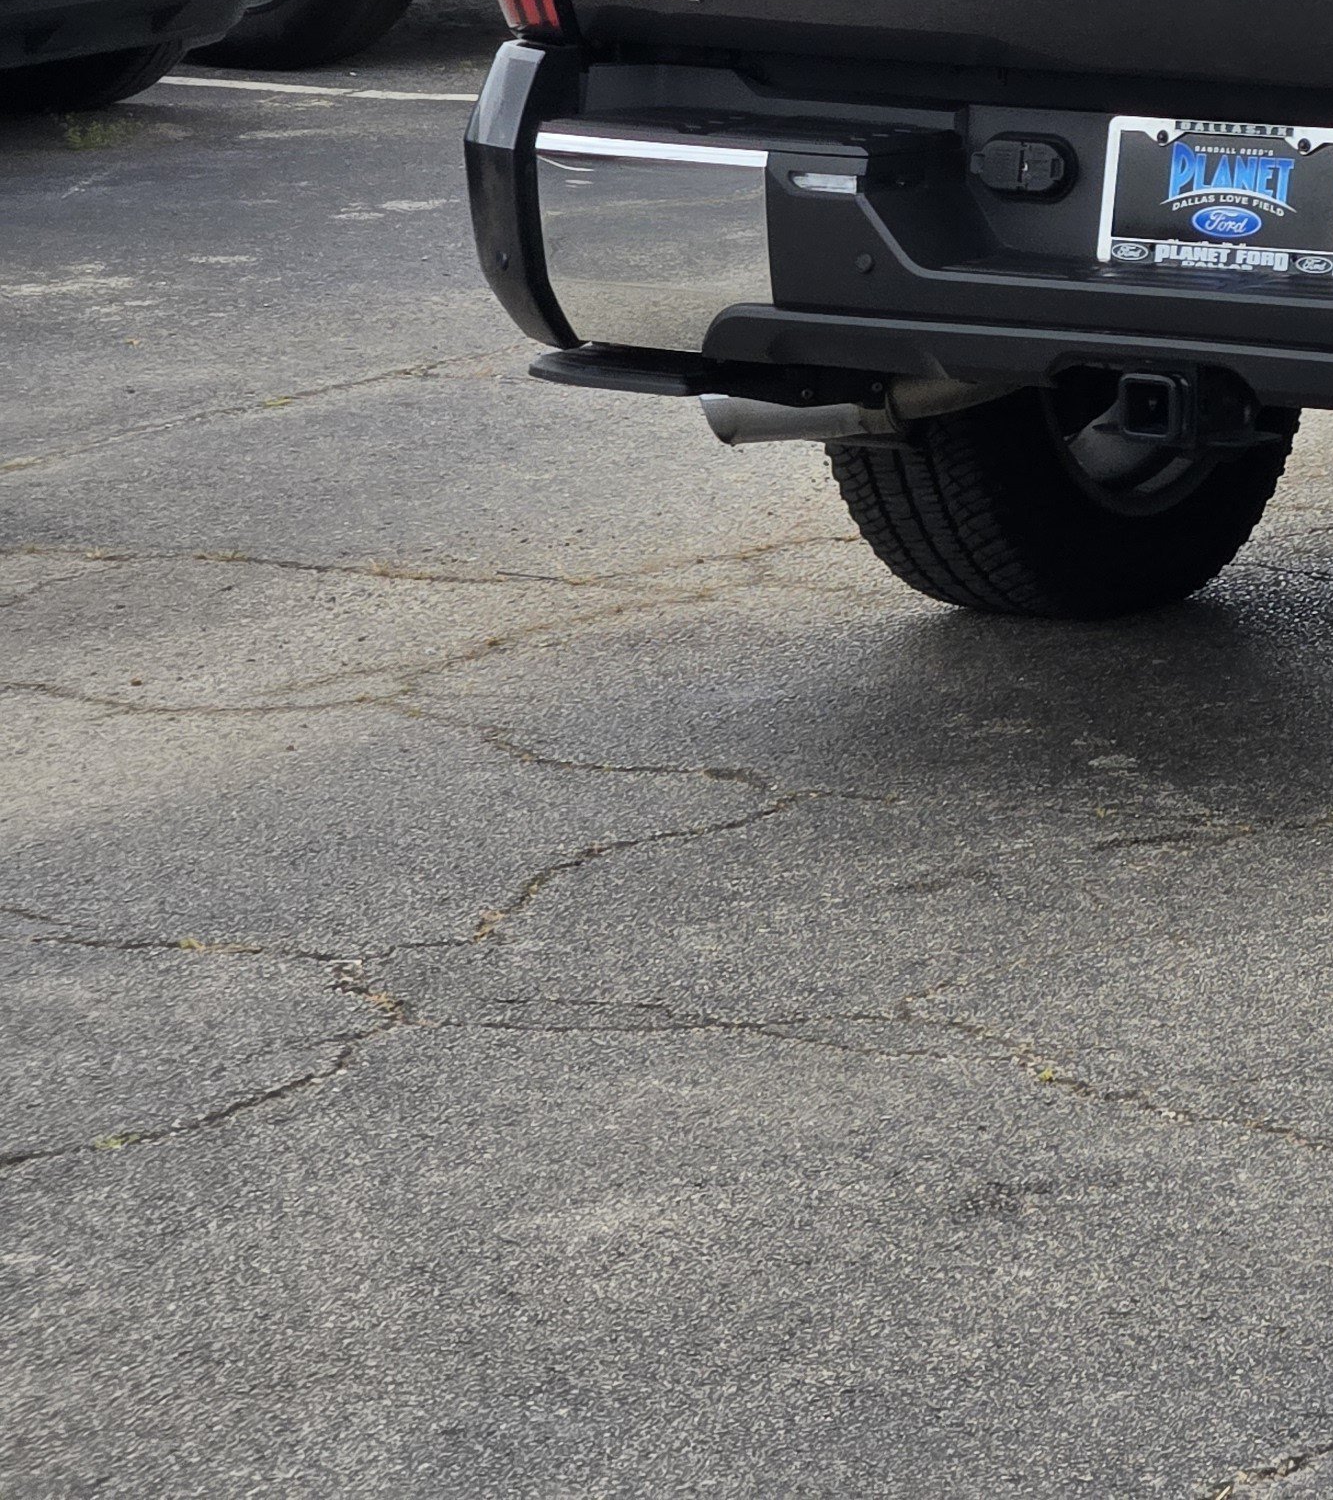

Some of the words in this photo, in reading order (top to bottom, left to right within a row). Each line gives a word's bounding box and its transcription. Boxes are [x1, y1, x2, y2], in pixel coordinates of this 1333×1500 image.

[1168, 140, 1296, 204] PLANET
[1172, 194, 1216, 212] DALLAS
[1219, 194, 1249, 206] LOVE
[1252, 198, 1286, 218] FIELD
[1204, 209, 1248, 234] Ford
[1153, 243, 1232, 264] PLANET
[1235, 248, 1290, 272] FORD
